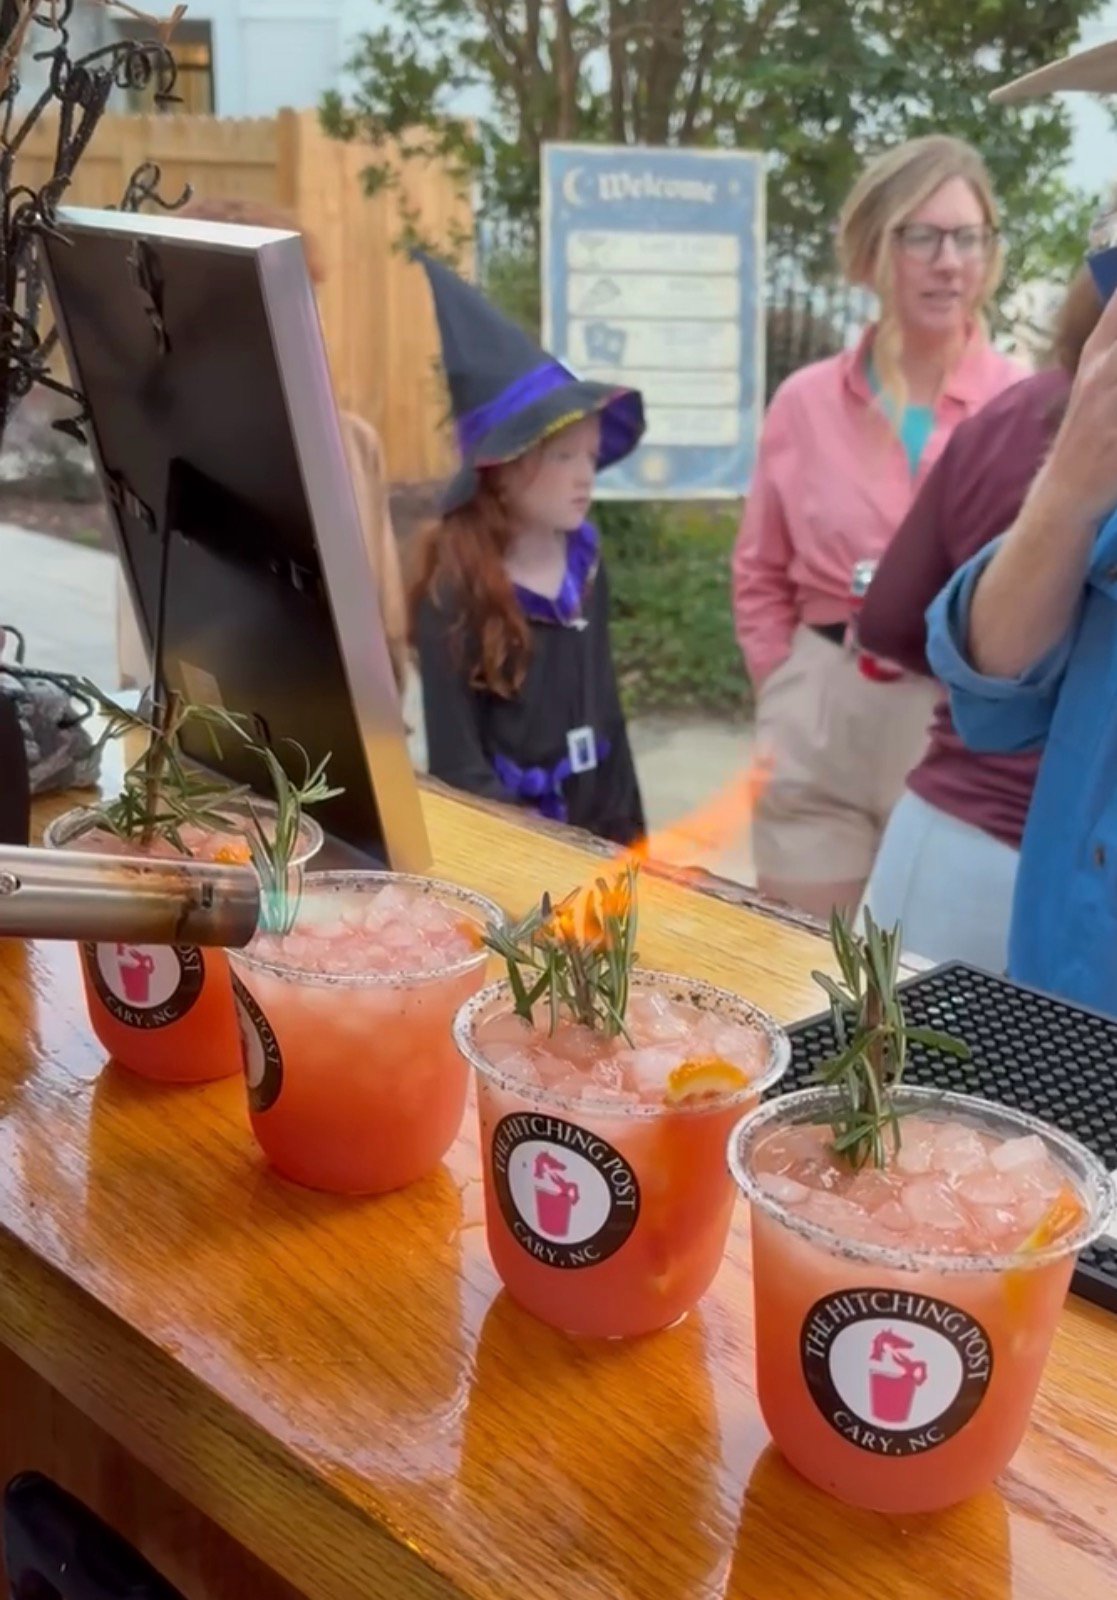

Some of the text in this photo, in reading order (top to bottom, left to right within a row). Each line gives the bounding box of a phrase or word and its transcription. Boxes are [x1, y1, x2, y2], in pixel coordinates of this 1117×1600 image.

[598, 172, 717, 204] Welcome
[152, 1005, 178, 1025] NC
[501, 1116, 609, 1160] HITCHING
[602, 1157, 636, 1211] POST
[569, 1244, 601, 1265] NC
[805, 1292, 990, 1381] THE HITCHING POST
[908, 1426, 945, 1452] NC
